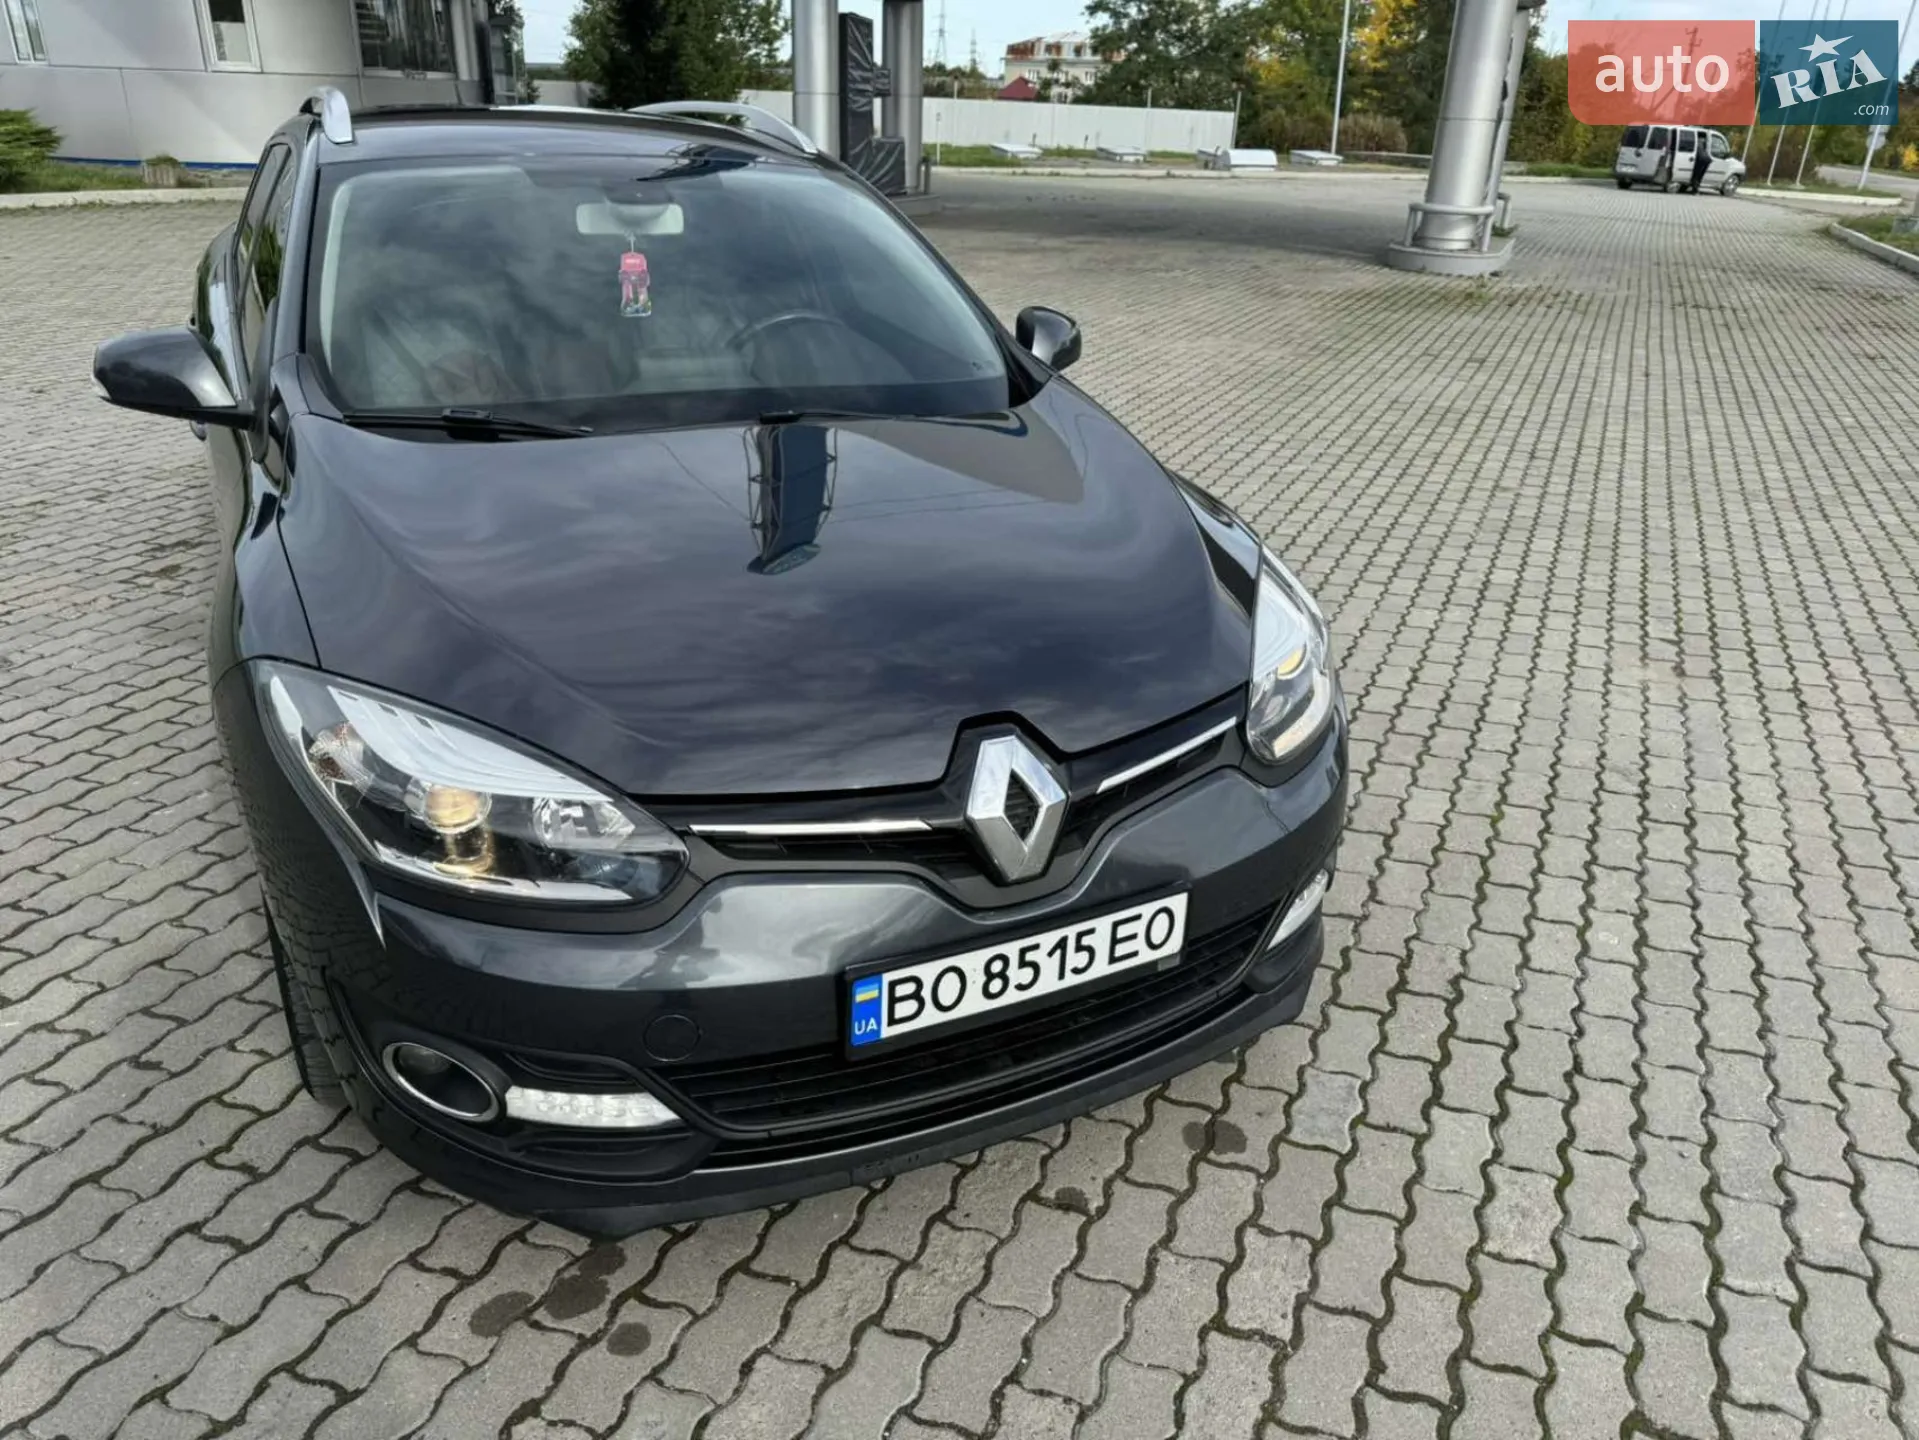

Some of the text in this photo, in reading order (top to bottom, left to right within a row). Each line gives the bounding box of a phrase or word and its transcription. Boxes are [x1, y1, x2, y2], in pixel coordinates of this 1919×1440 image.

[886, 905, 1176, 1027] BO 8515 EO
[854, 1017, 878, 1035] UA
